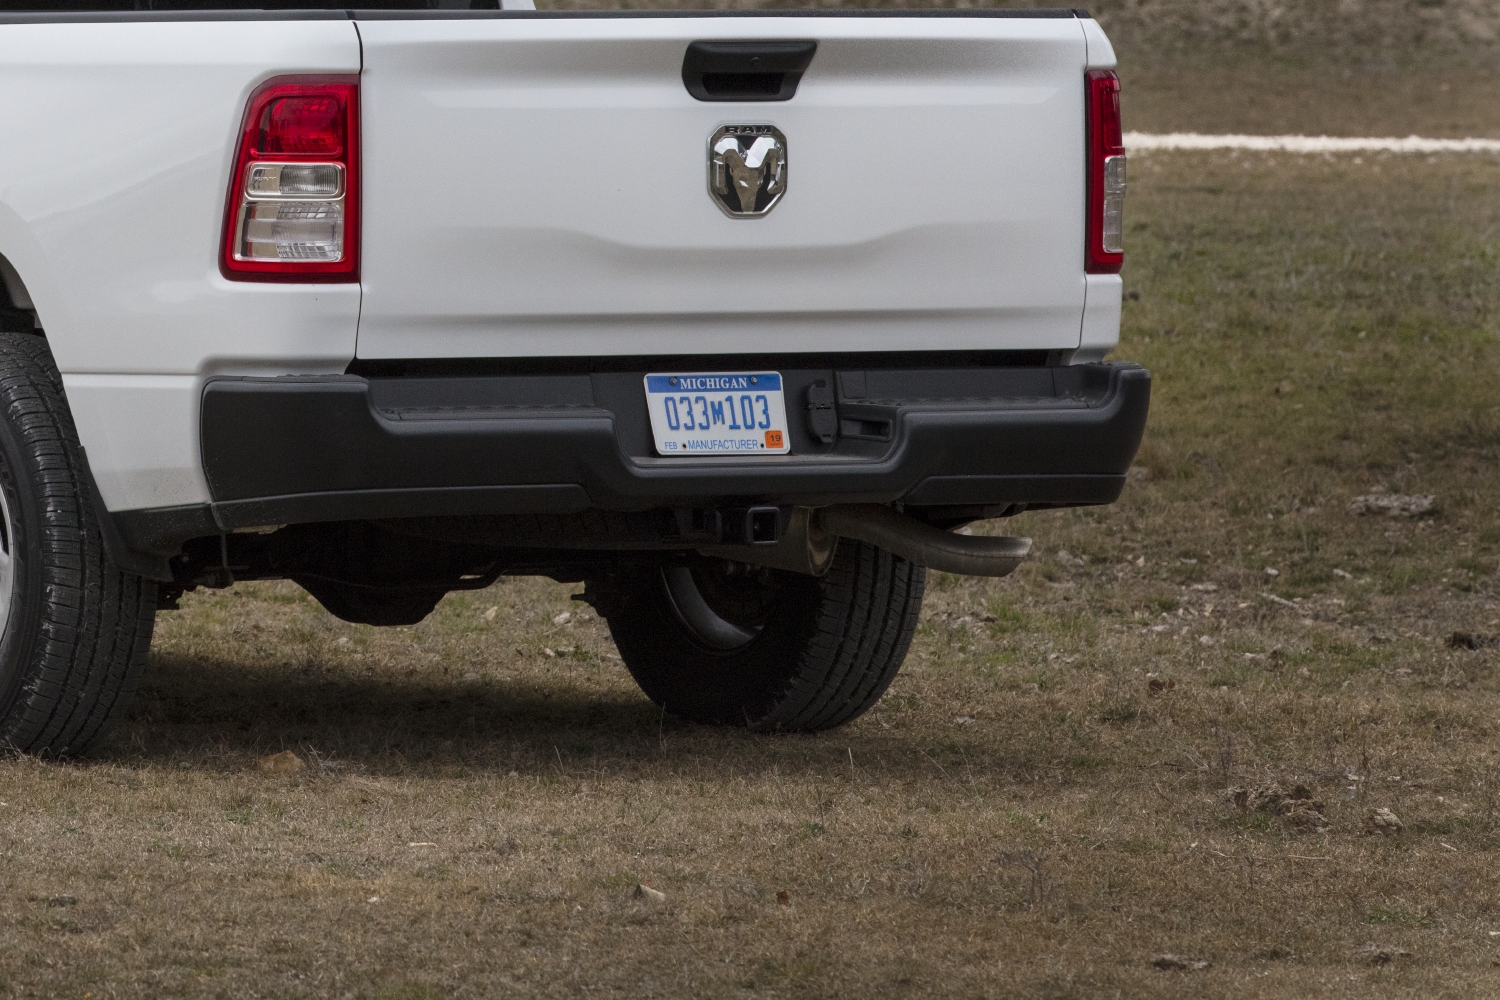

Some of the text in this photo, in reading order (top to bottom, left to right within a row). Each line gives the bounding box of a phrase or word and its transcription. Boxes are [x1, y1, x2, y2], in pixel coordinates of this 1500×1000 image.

[725, 125, 773, 135] RAM
[680, 377, 747, 390] MICHIGAN
[664, 395, 771, 430] 033M103
[769, 434, 781, 442] 19
[664, 439, 759, 450] FEB MANUFACTURER
